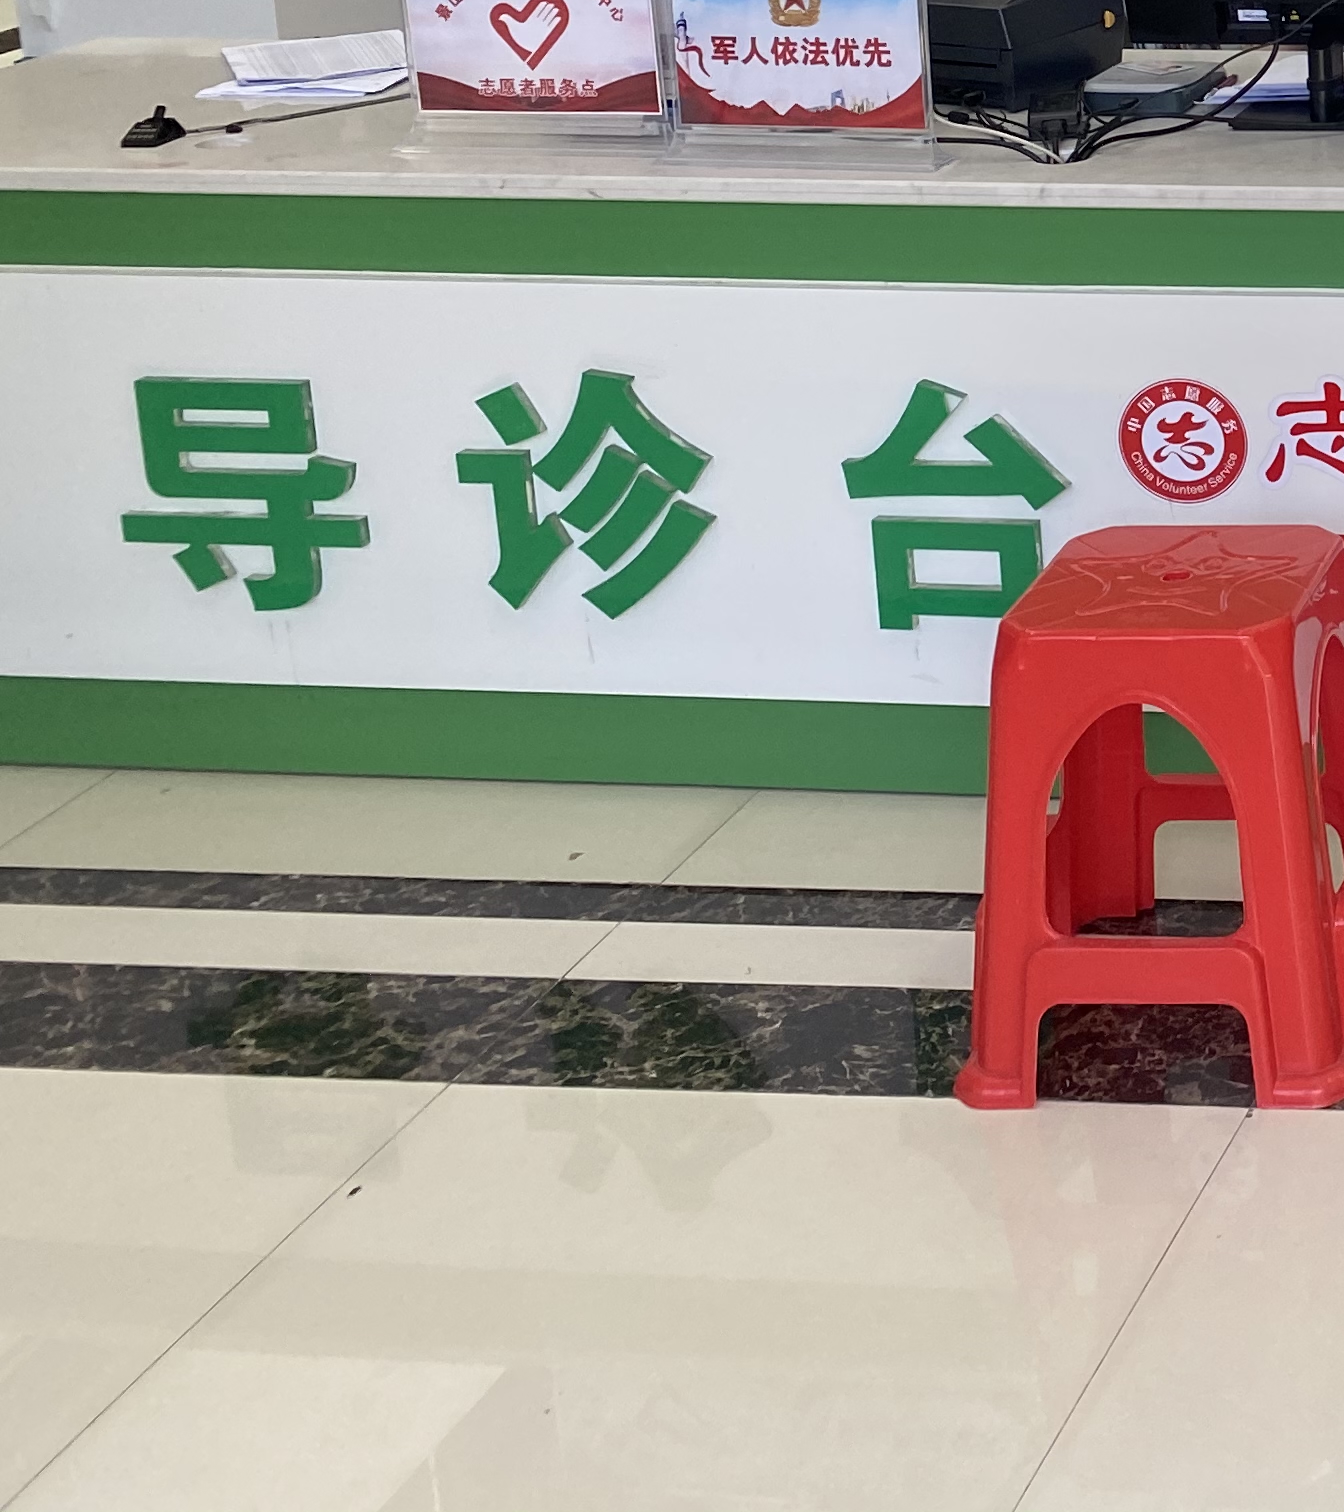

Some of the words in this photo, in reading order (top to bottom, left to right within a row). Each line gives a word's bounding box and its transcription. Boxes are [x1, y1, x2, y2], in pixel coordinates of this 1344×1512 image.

[710, 35, 893, 69] 军人依法优先
[477, 76, 599, 99] 志愿者服务点
[1126, 385, 1239, 434] 中国志愿服务
[1131, 451, 1155, 481] China
[1155, 476, 1208, 495] Volunteer
[1207, 452, 1238, 488] Service
[120, 368, 1074, 630] 导诊台
